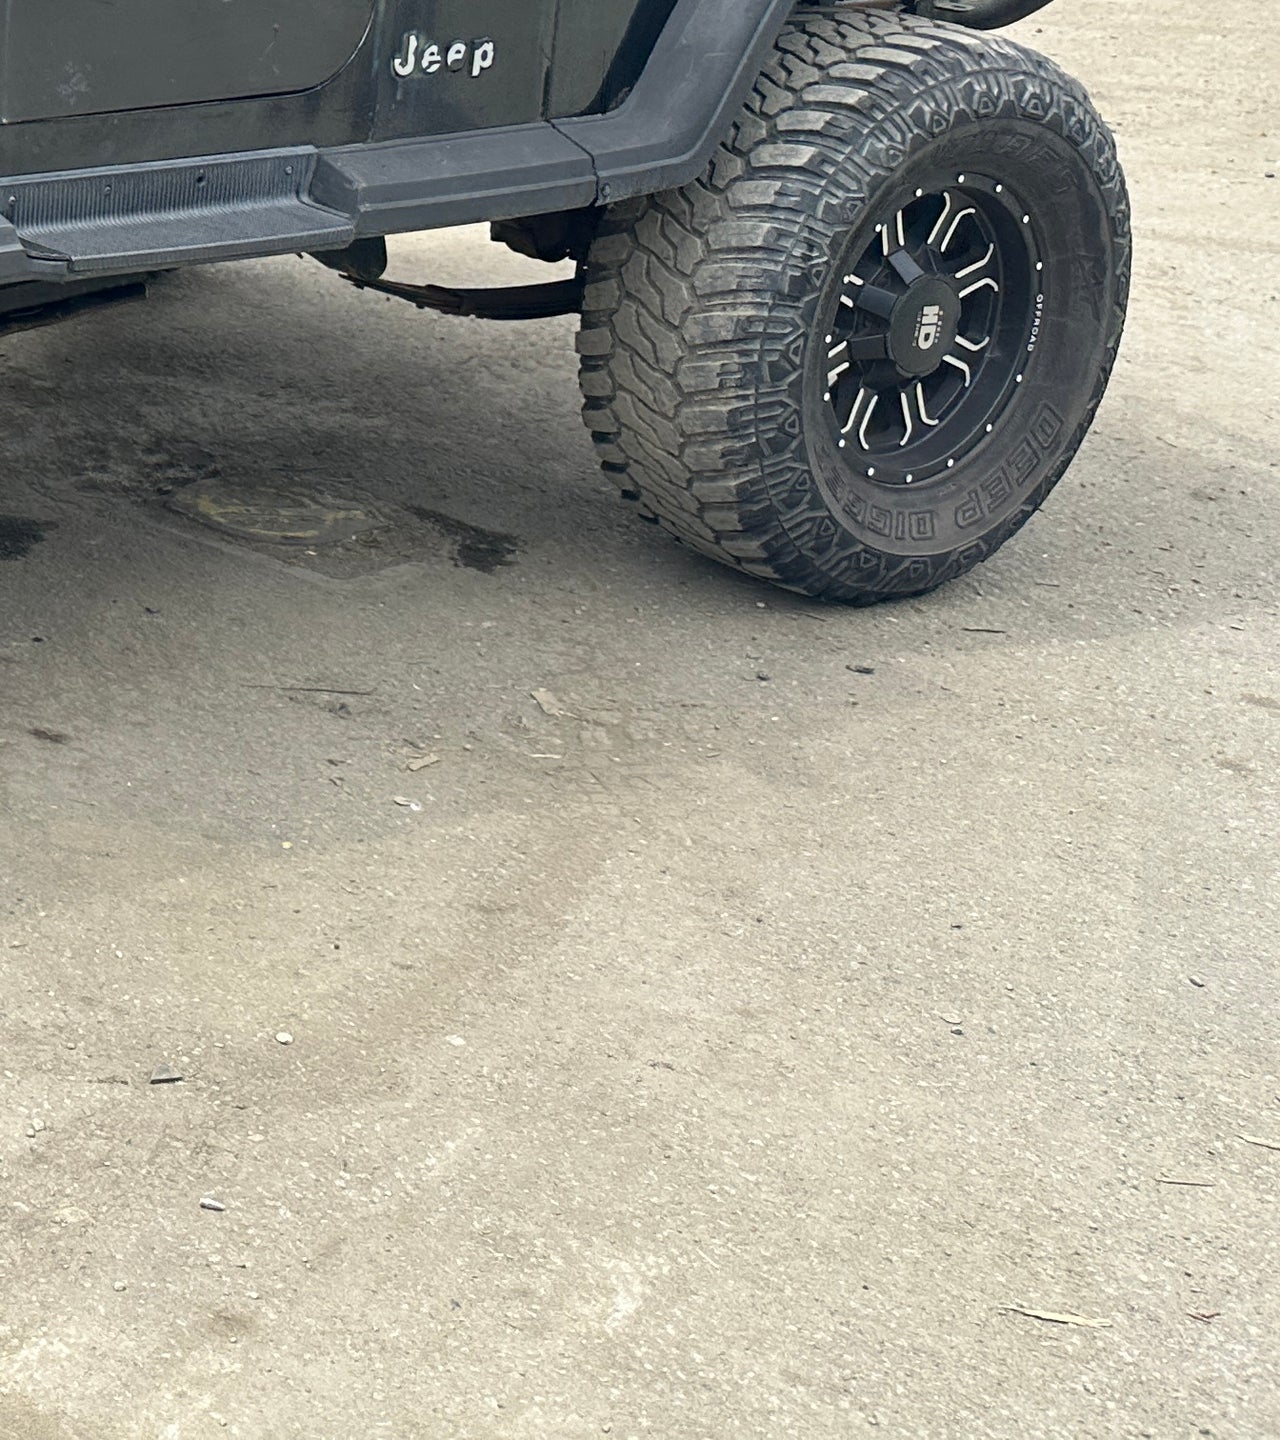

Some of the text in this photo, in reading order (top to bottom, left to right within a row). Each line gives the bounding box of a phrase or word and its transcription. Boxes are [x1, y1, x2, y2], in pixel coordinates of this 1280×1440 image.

[393, 33, 495, 77] Jeep
[1027, 293, 1044, 352] OFFROAD
[955, 402, 1063, 530] DEEP
